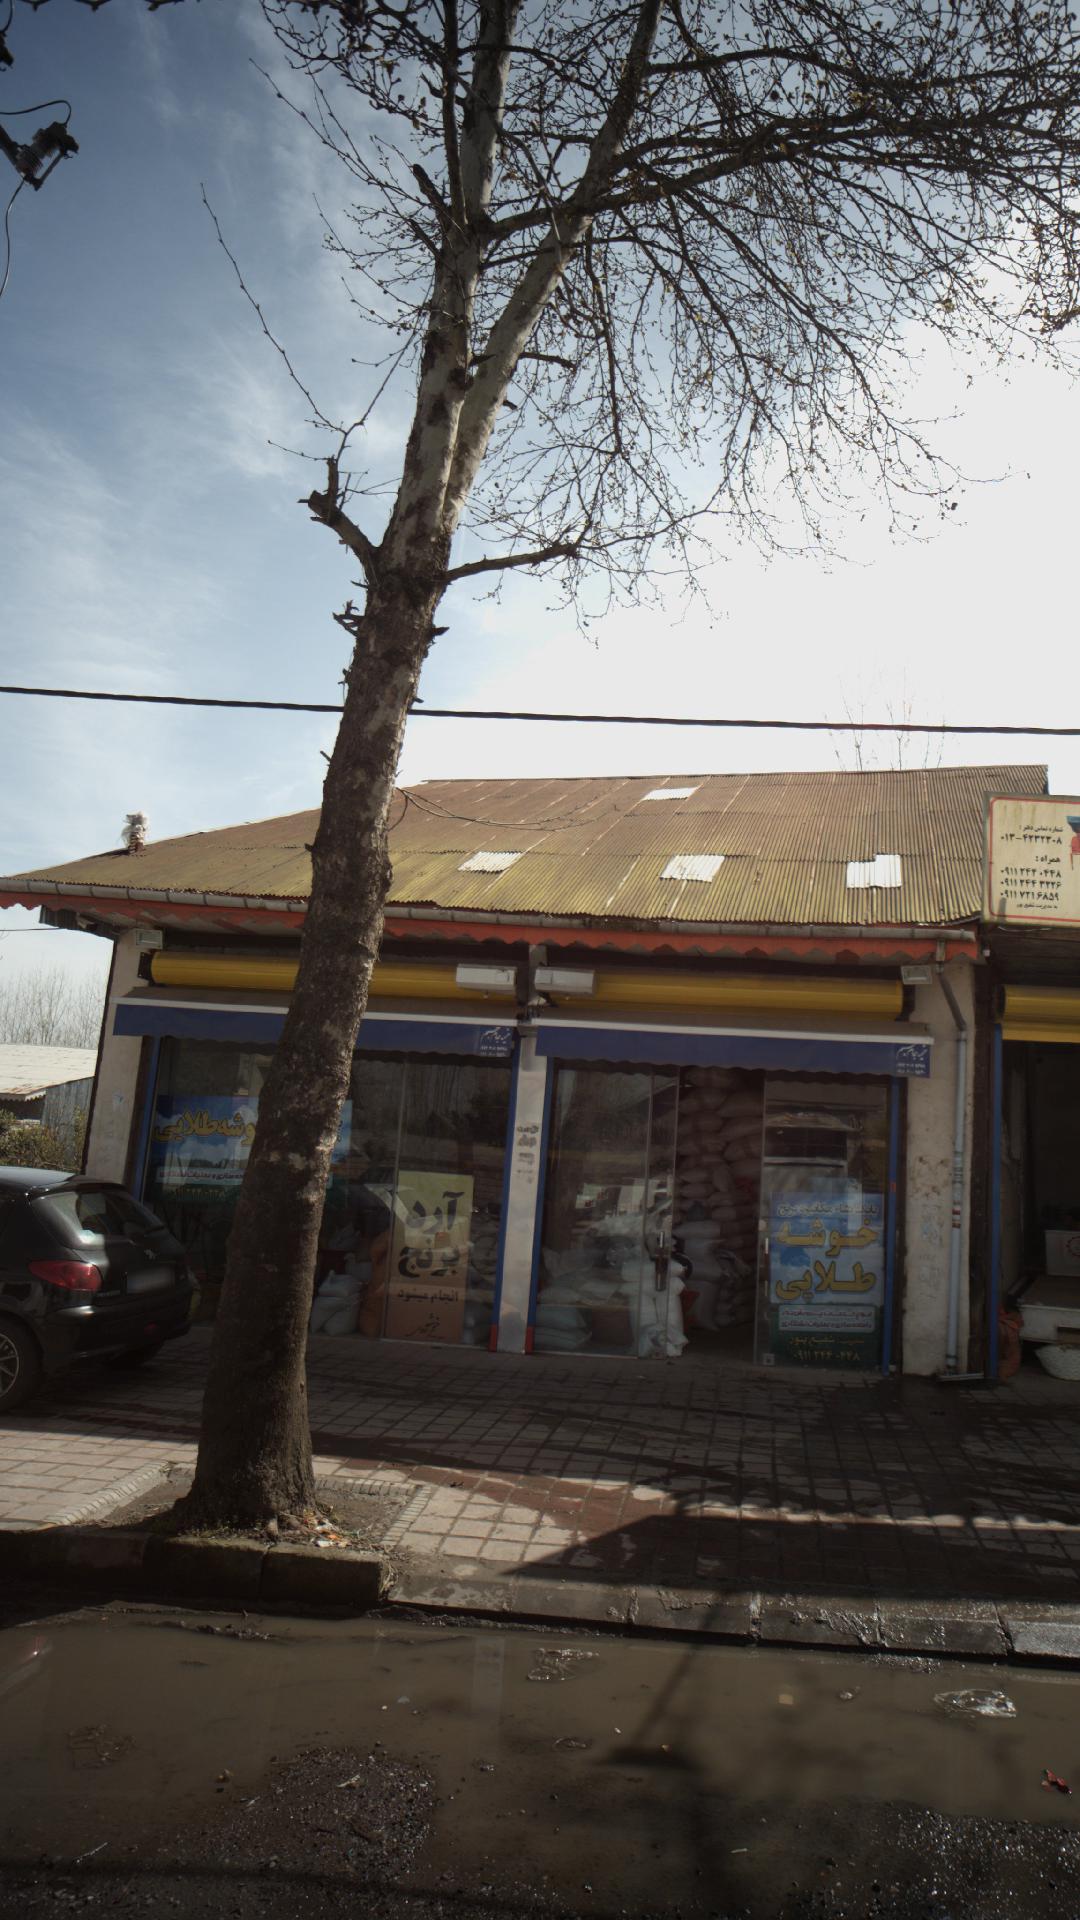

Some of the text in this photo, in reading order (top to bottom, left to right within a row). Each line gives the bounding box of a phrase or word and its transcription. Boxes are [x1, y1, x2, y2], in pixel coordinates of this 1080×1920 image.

[405, 1191, 465, 1234] آرد
[776, 1218, 879, 1257] خوشه
[775, 1260, 877, 1300] طلایی
